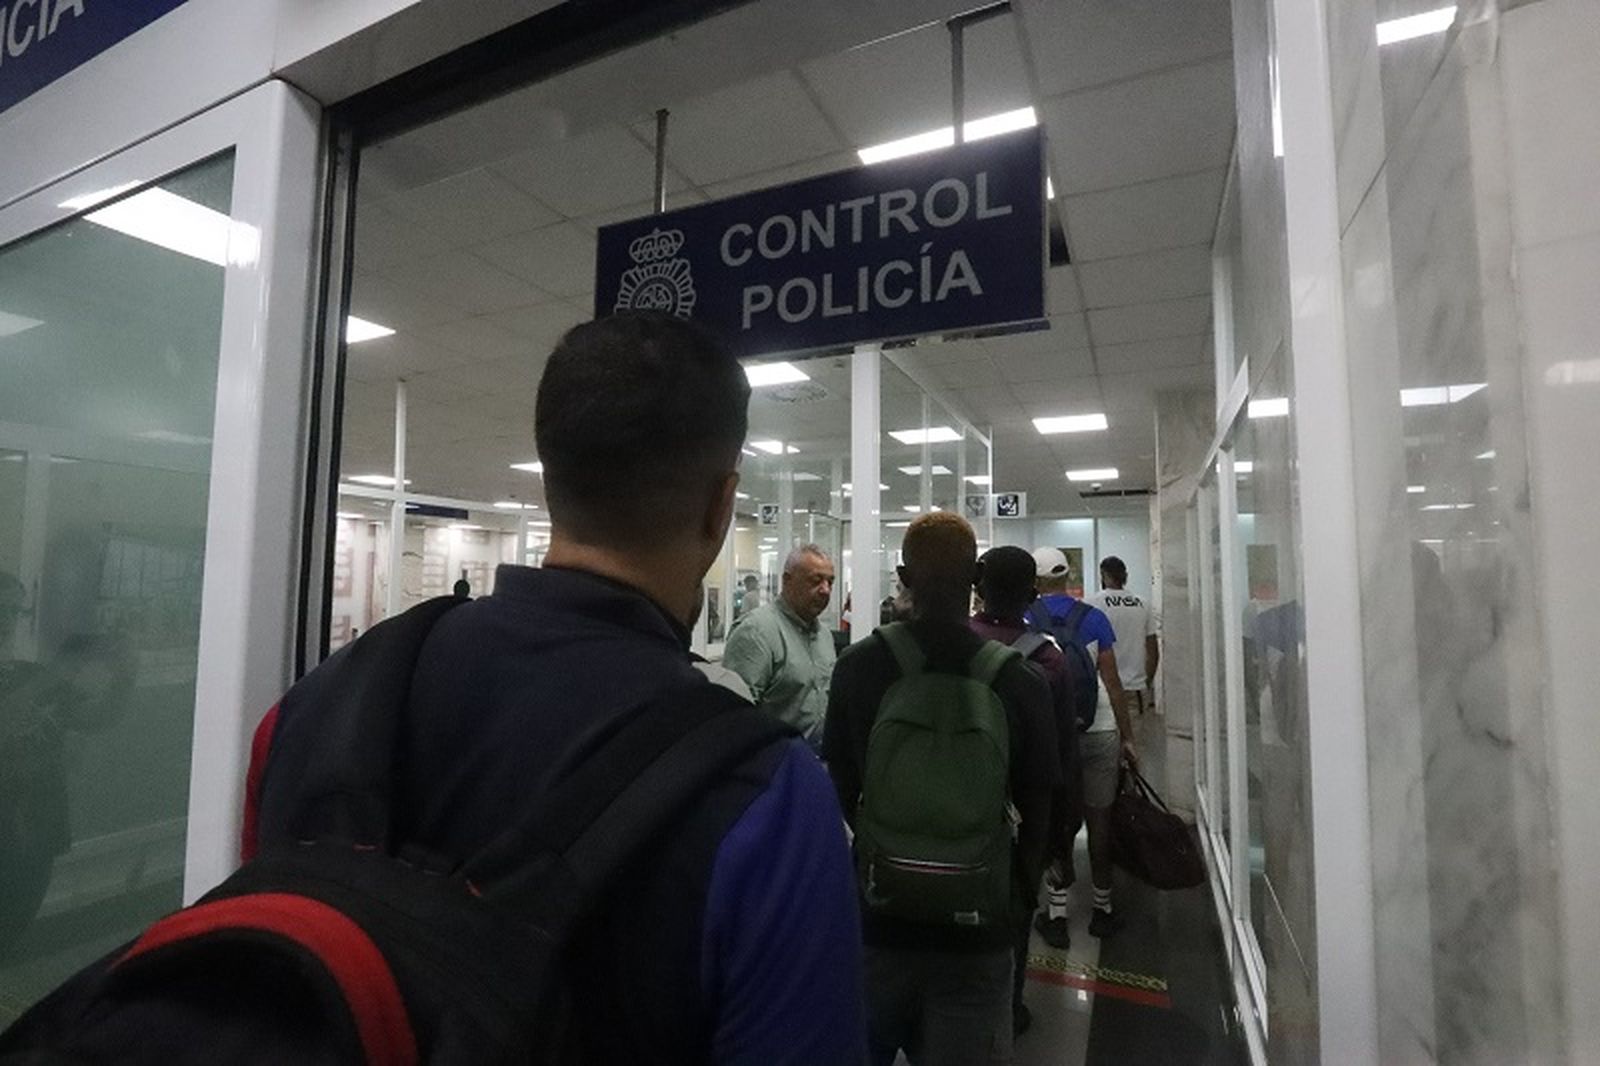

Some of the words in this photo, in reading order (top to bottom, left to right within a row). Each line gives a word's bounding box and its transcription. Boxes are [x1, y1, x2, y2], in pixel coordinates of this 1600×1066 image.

[720, 172, 1013, 267] CONTROL
[741, 242, 983, 330] POLICÍA
[1105, 595, 1144, 608] NASA
